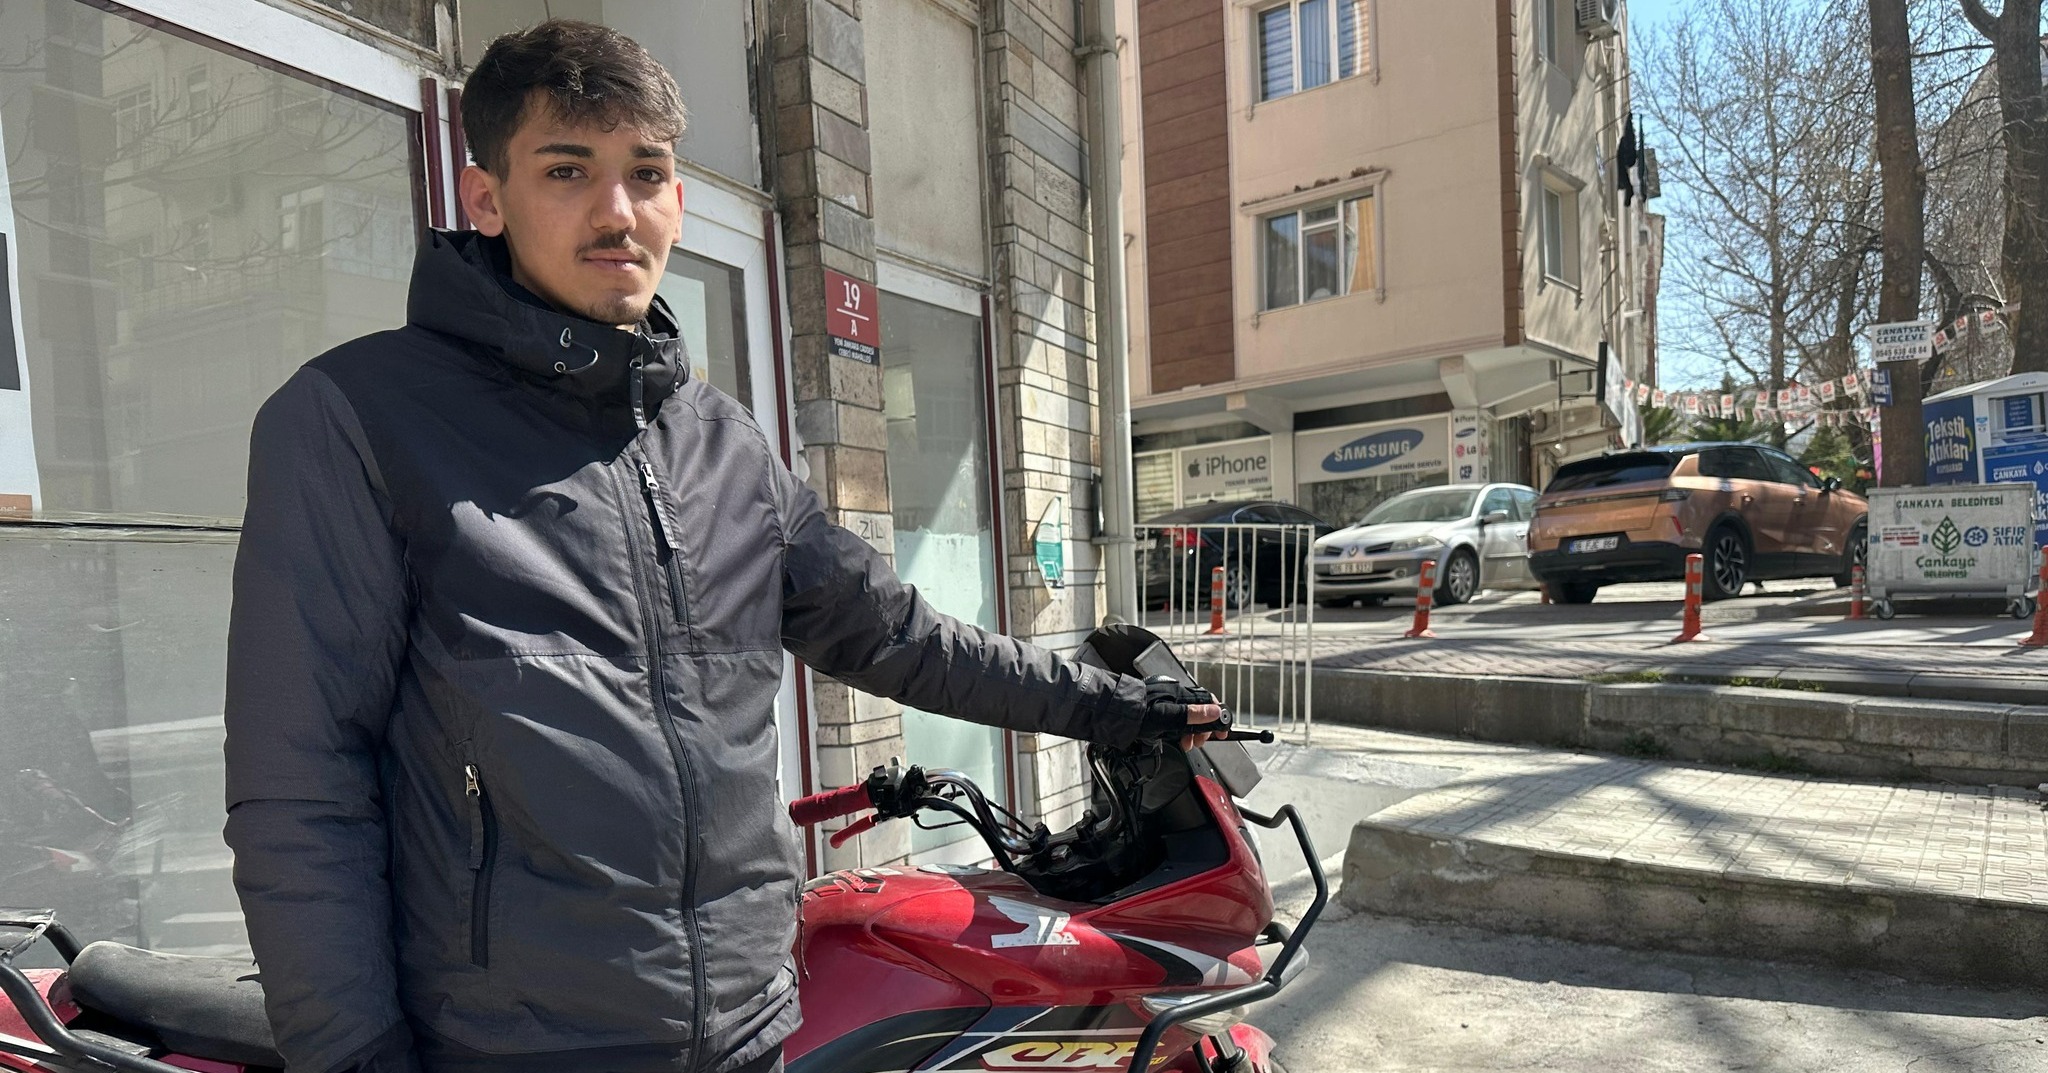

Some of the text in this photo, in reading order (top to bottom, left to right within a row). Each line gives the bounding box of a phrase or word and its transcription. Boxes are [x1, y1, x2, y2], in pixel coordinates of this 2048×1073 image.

[843, 280, 861, 311] 19
[850, 319, 859, 337] A
[1877, 326, 1927, 337] SANATSAL
[1876, 333, 1924, 345] ÇERÇEVE
[1928, 415, 1966, 442] Tekstil
[1334, 440, 1411, 462] SAMSUNG
[1466, 445, 1477, 455] LG
[1929, 438, 1969, 467] Atıkları
[1206, 454, 1267, 476] iPhone
[1994, 468, 2028, 481] ÇANKAYA
[1896, 495, 2003, 510] ÇANKAYA BELEDİYESİ
[1993, 526, 2026, 537] SIFIR
[1993, 536, 2024, 546] ATIK
[1916, 555, 1976, 569] Çankaya
[1924, 569, 1967, 579] BELEDİYESİ
